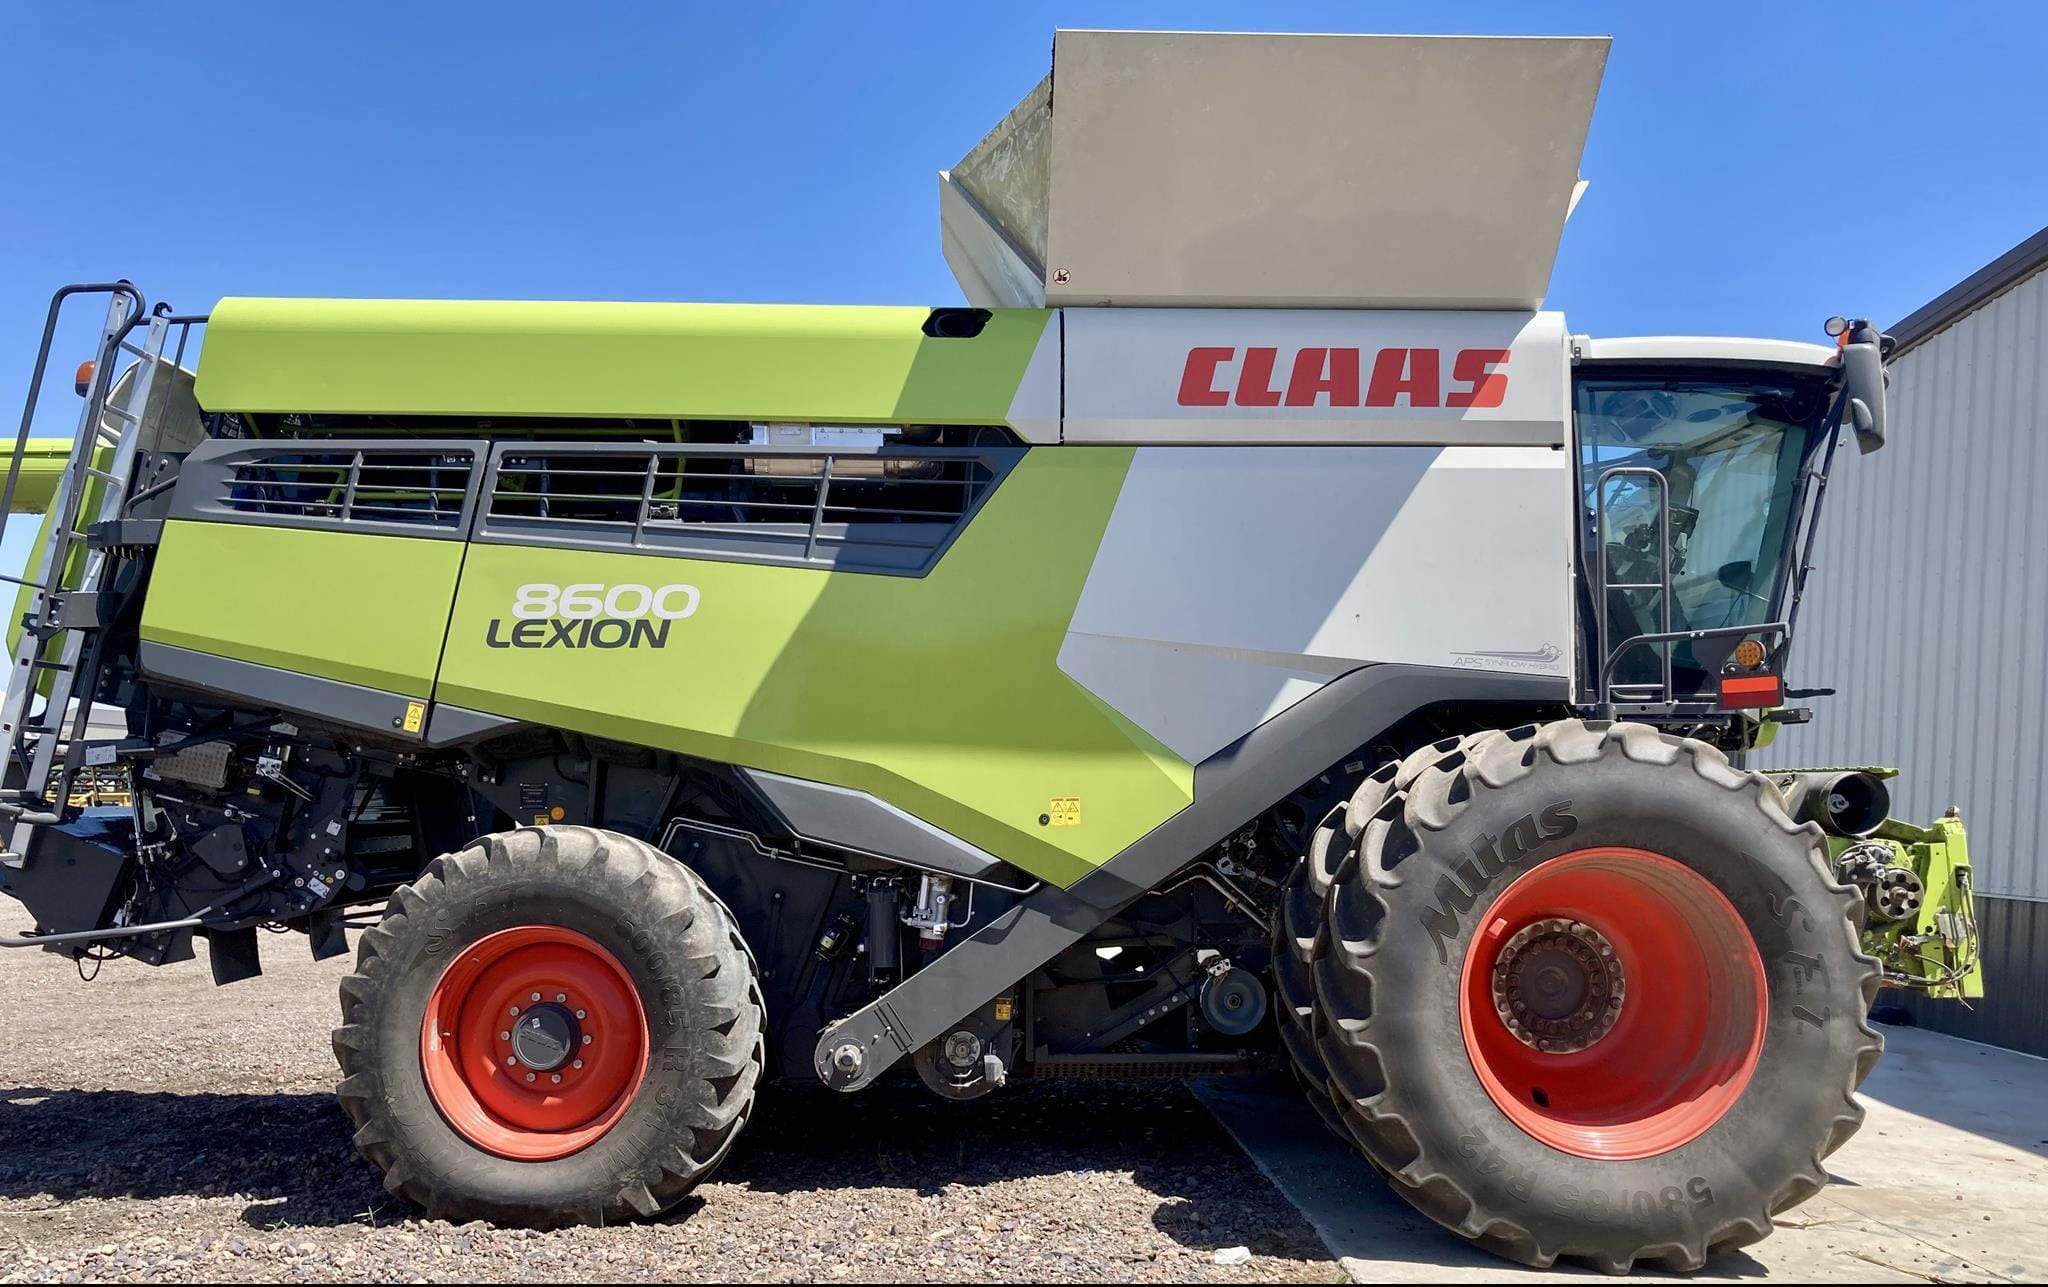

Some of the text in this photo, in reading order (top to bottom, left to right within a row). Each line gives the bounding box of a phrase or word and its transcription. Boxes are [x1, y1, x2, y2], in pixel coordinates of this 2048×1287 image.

[1177, 346, 1512, 408] CLAAS
[512, 583, 700, 620] 8600
[486, 618, 672, 649] LEXION
[1453, 656, 1484, 668] APS
[1419, 799, 1578, 966] Mitas
